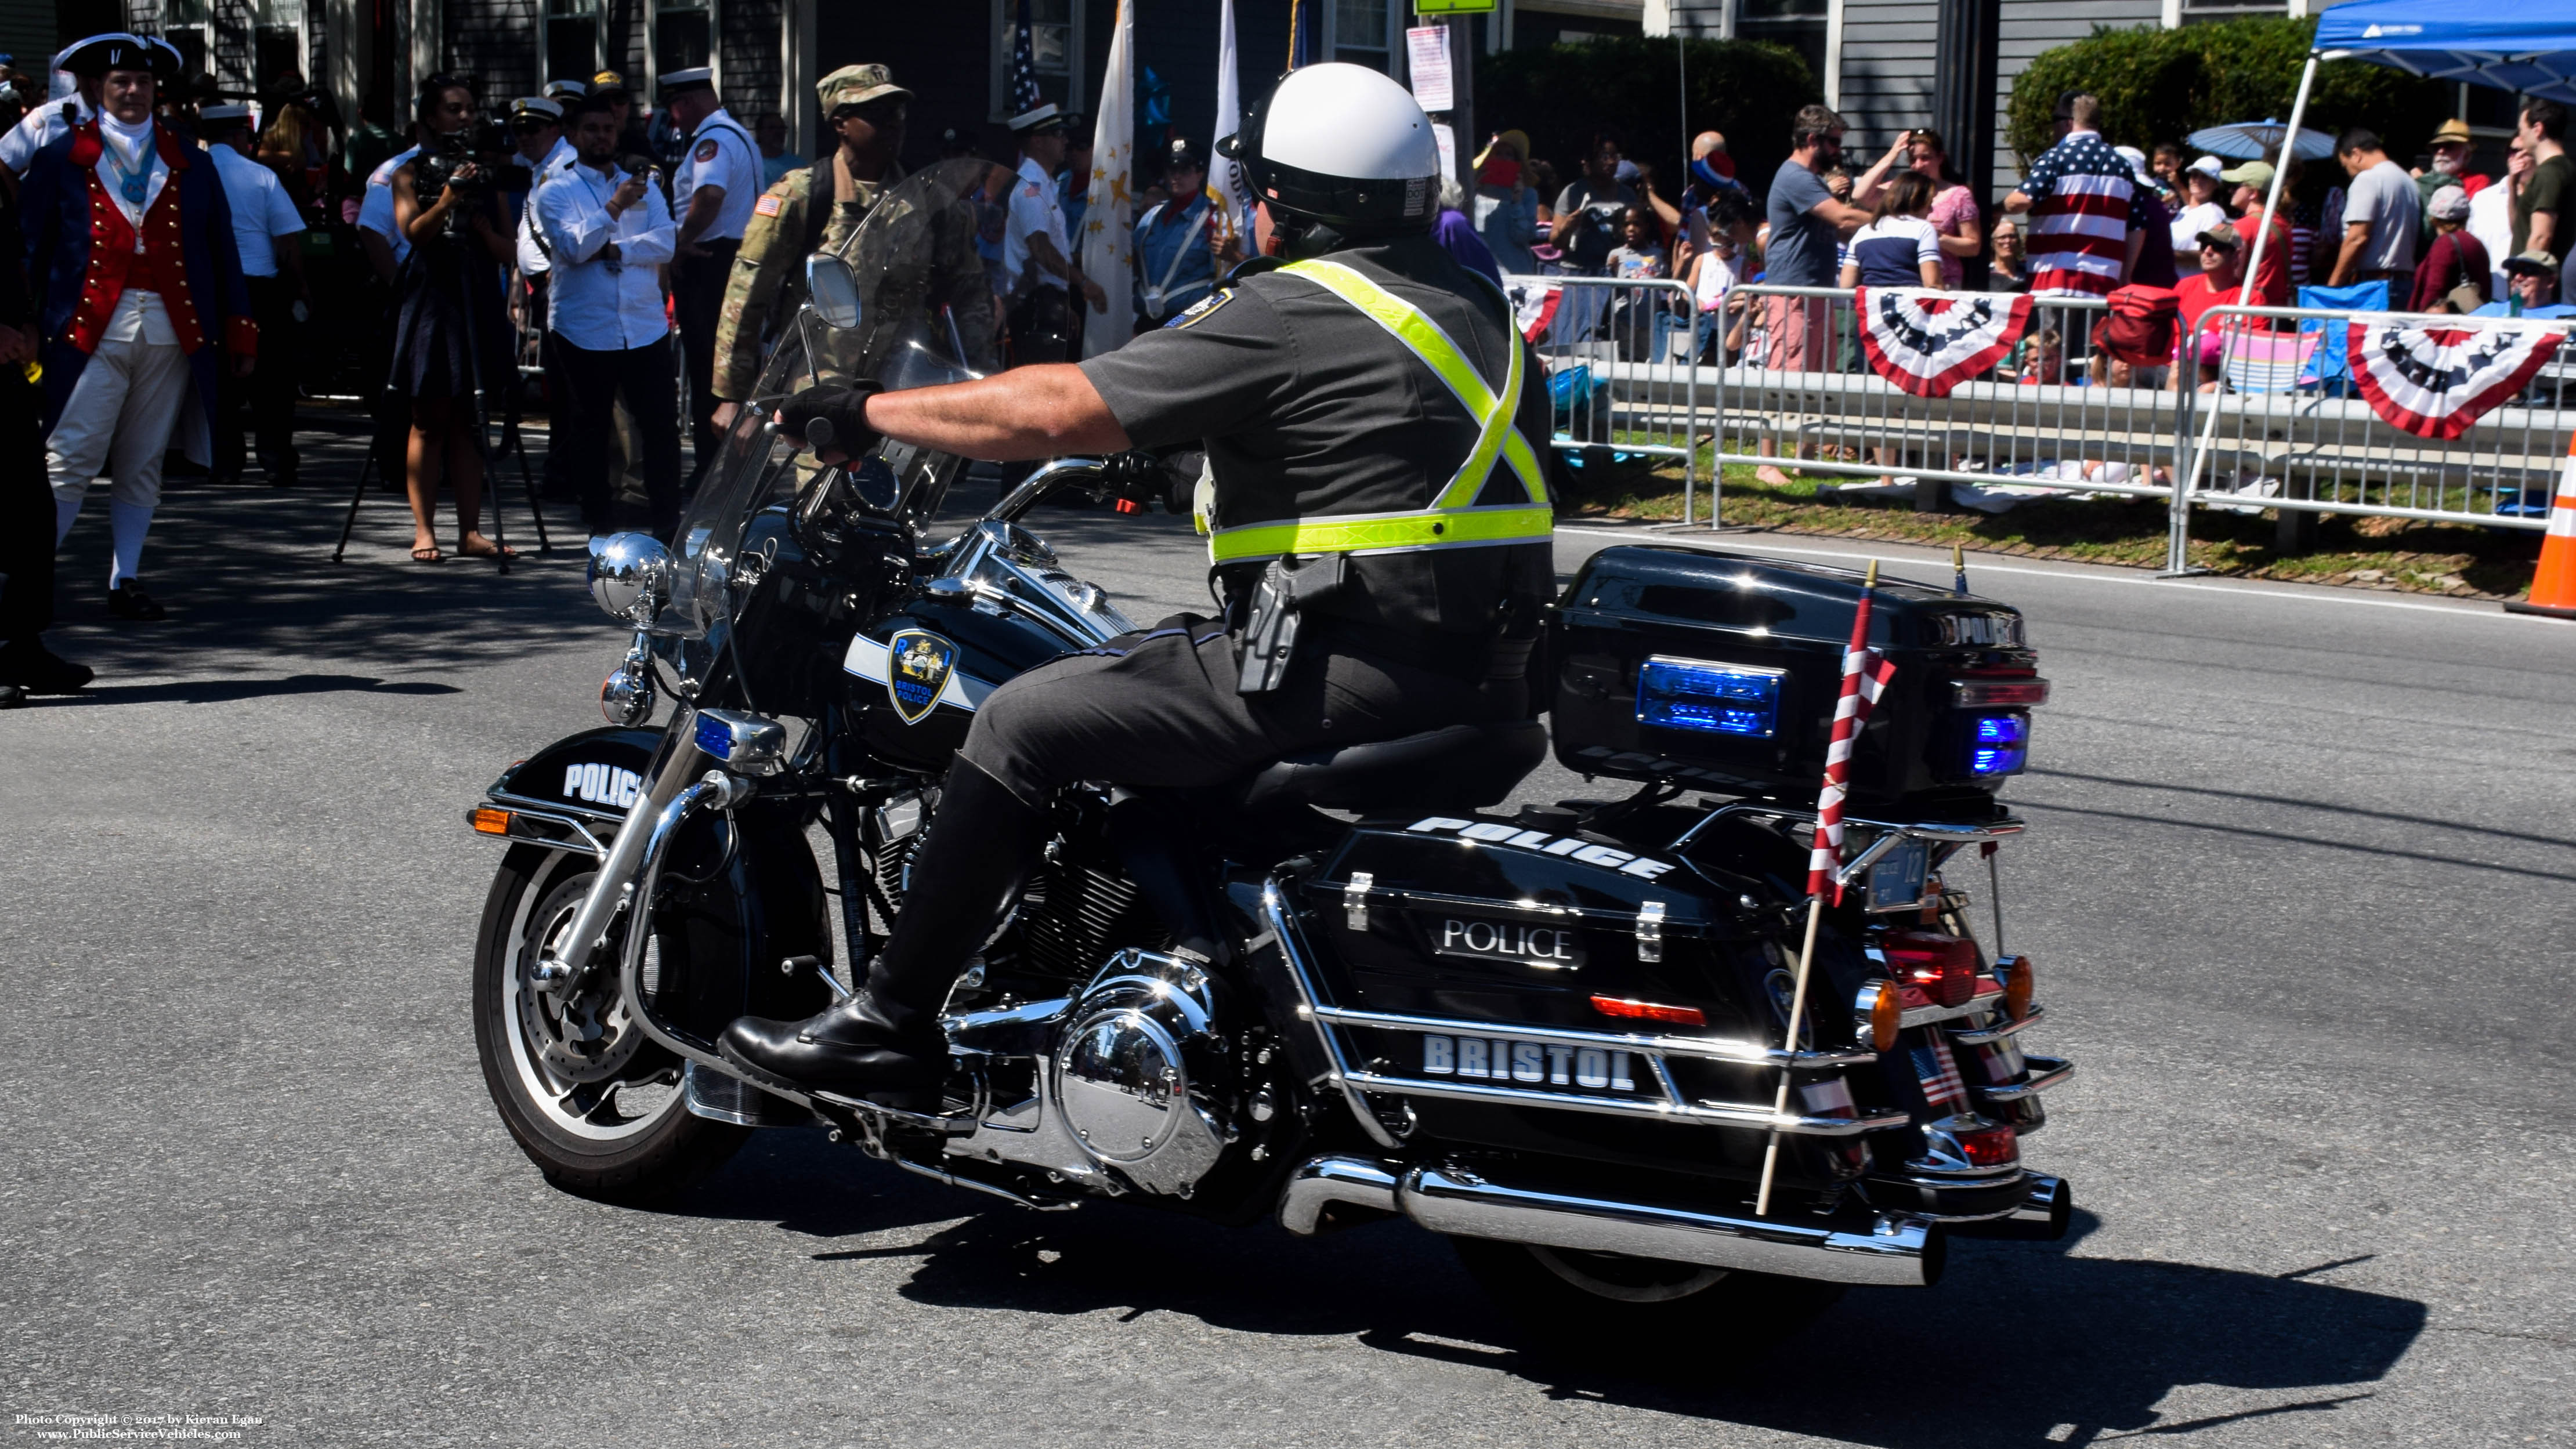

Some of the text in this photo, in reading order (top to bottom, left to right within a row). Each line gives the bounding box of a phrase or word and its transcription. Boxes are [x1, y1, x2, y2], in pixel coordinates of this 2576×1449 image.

[895, 637, 908, 655] R
[895, 680, 933, 697] BRISTOL
[897, 690, 929, 705] POLICE
[1406, 817, 1677, 879] POLICE
[1444, 919, 1573, 959] POLICE
[1423, 1034, 1636, 1091] BRISTOL
